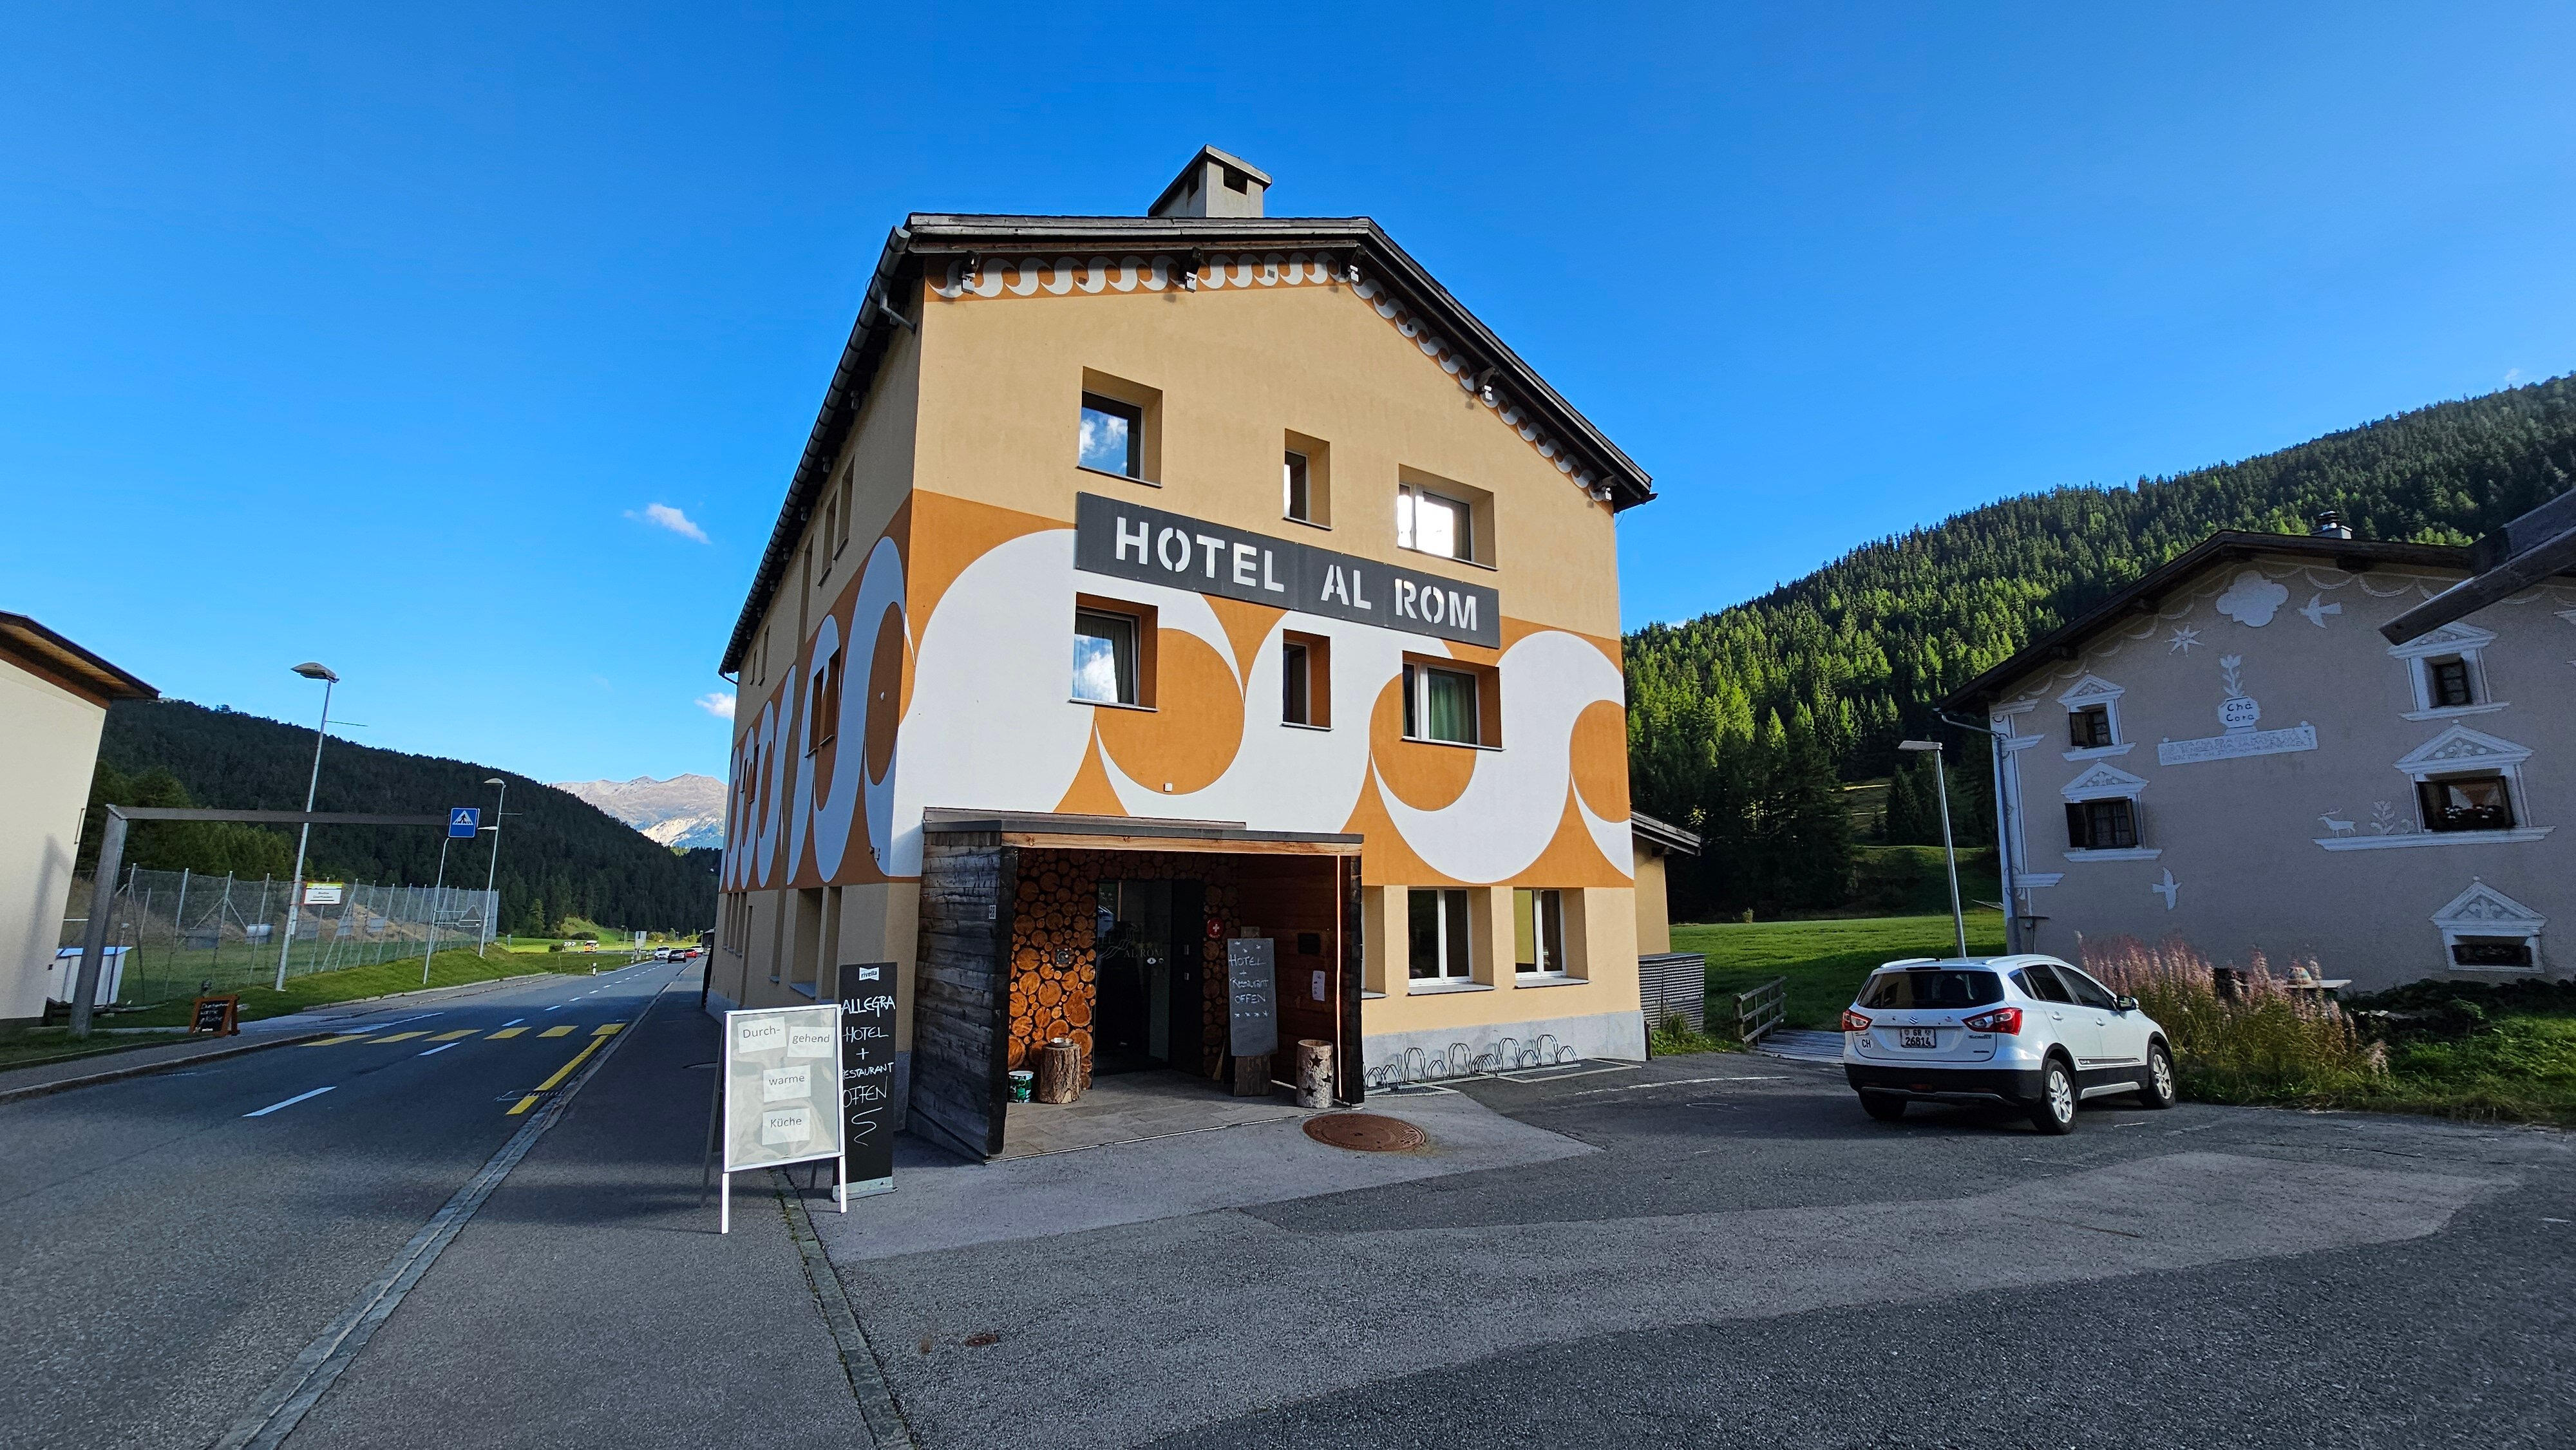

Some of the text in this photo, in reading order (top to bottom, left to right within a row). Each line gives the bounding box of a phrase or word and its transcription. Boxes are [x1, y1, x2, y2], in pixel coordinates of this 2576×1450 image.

[1115, 516, 1477, 631] HOTEL AL ROM
[1229, 954, 1266, 966] HOTEL
[1235, 992, 1265, 1004] OFFEN
[840, 995, 896, 1017] ALLEGRA
[743, 1025, 830, 1044] Durch- gehend
[842, 1026, 889, 1043] HOTEL
[1862, 1039, 1871, 1048] CH
[1905, 1037, 1931, 1047] 26814
[768, 1075, 805, 1086] warme
[770, 1116, 802, 1128] Küche
